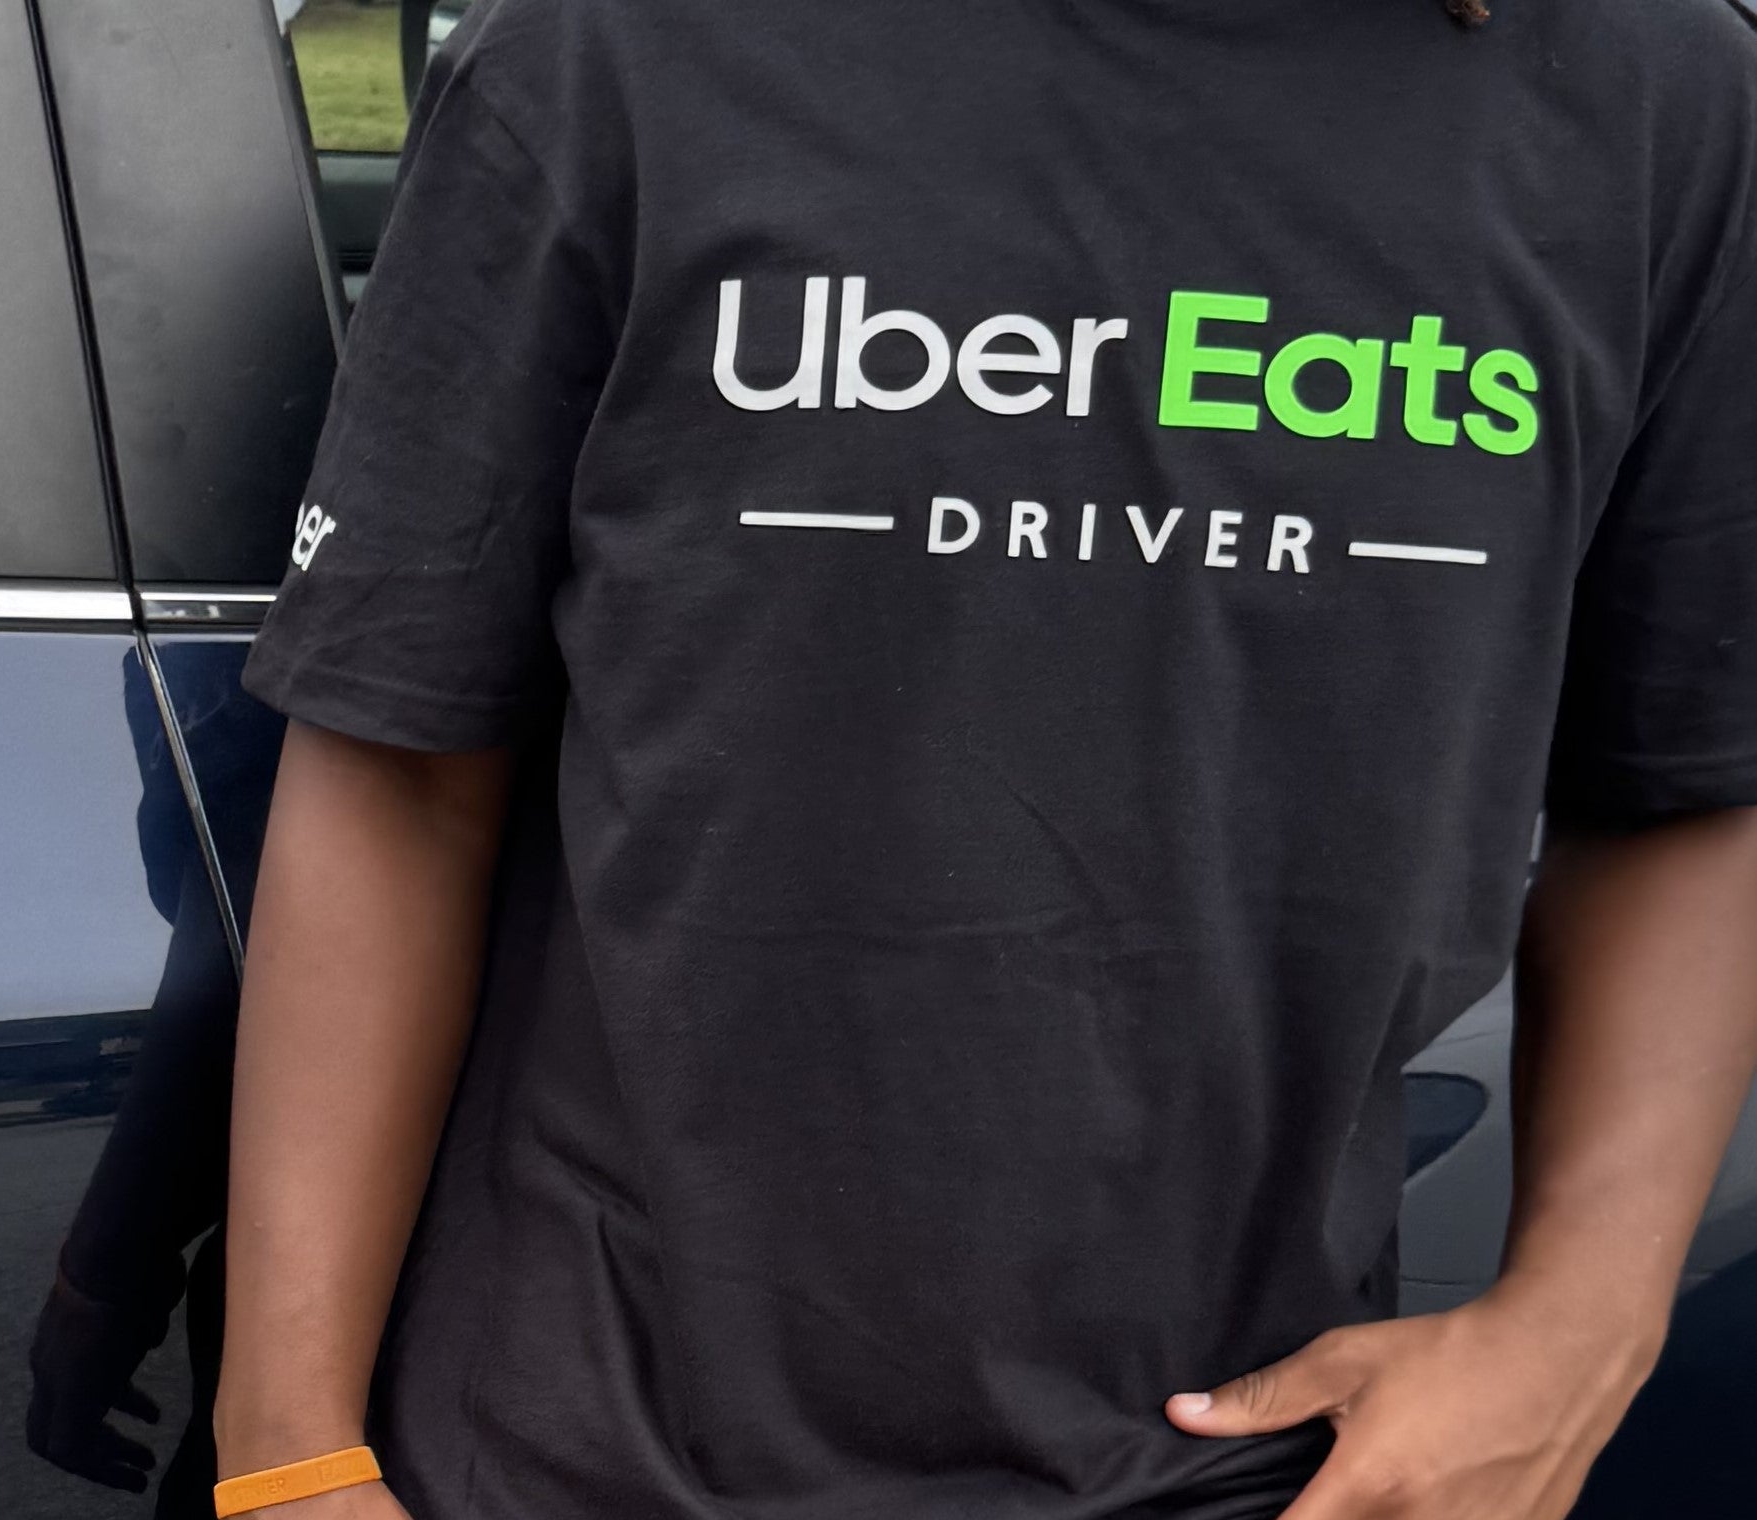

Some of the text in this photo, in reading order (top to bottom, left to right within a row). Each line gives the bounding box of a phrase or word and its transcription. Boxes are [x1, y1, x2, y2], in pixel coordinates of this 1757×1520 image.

[711, 275, 1540, 457] Uber Eats
[926, 495, 1315, 575] DRIVER
